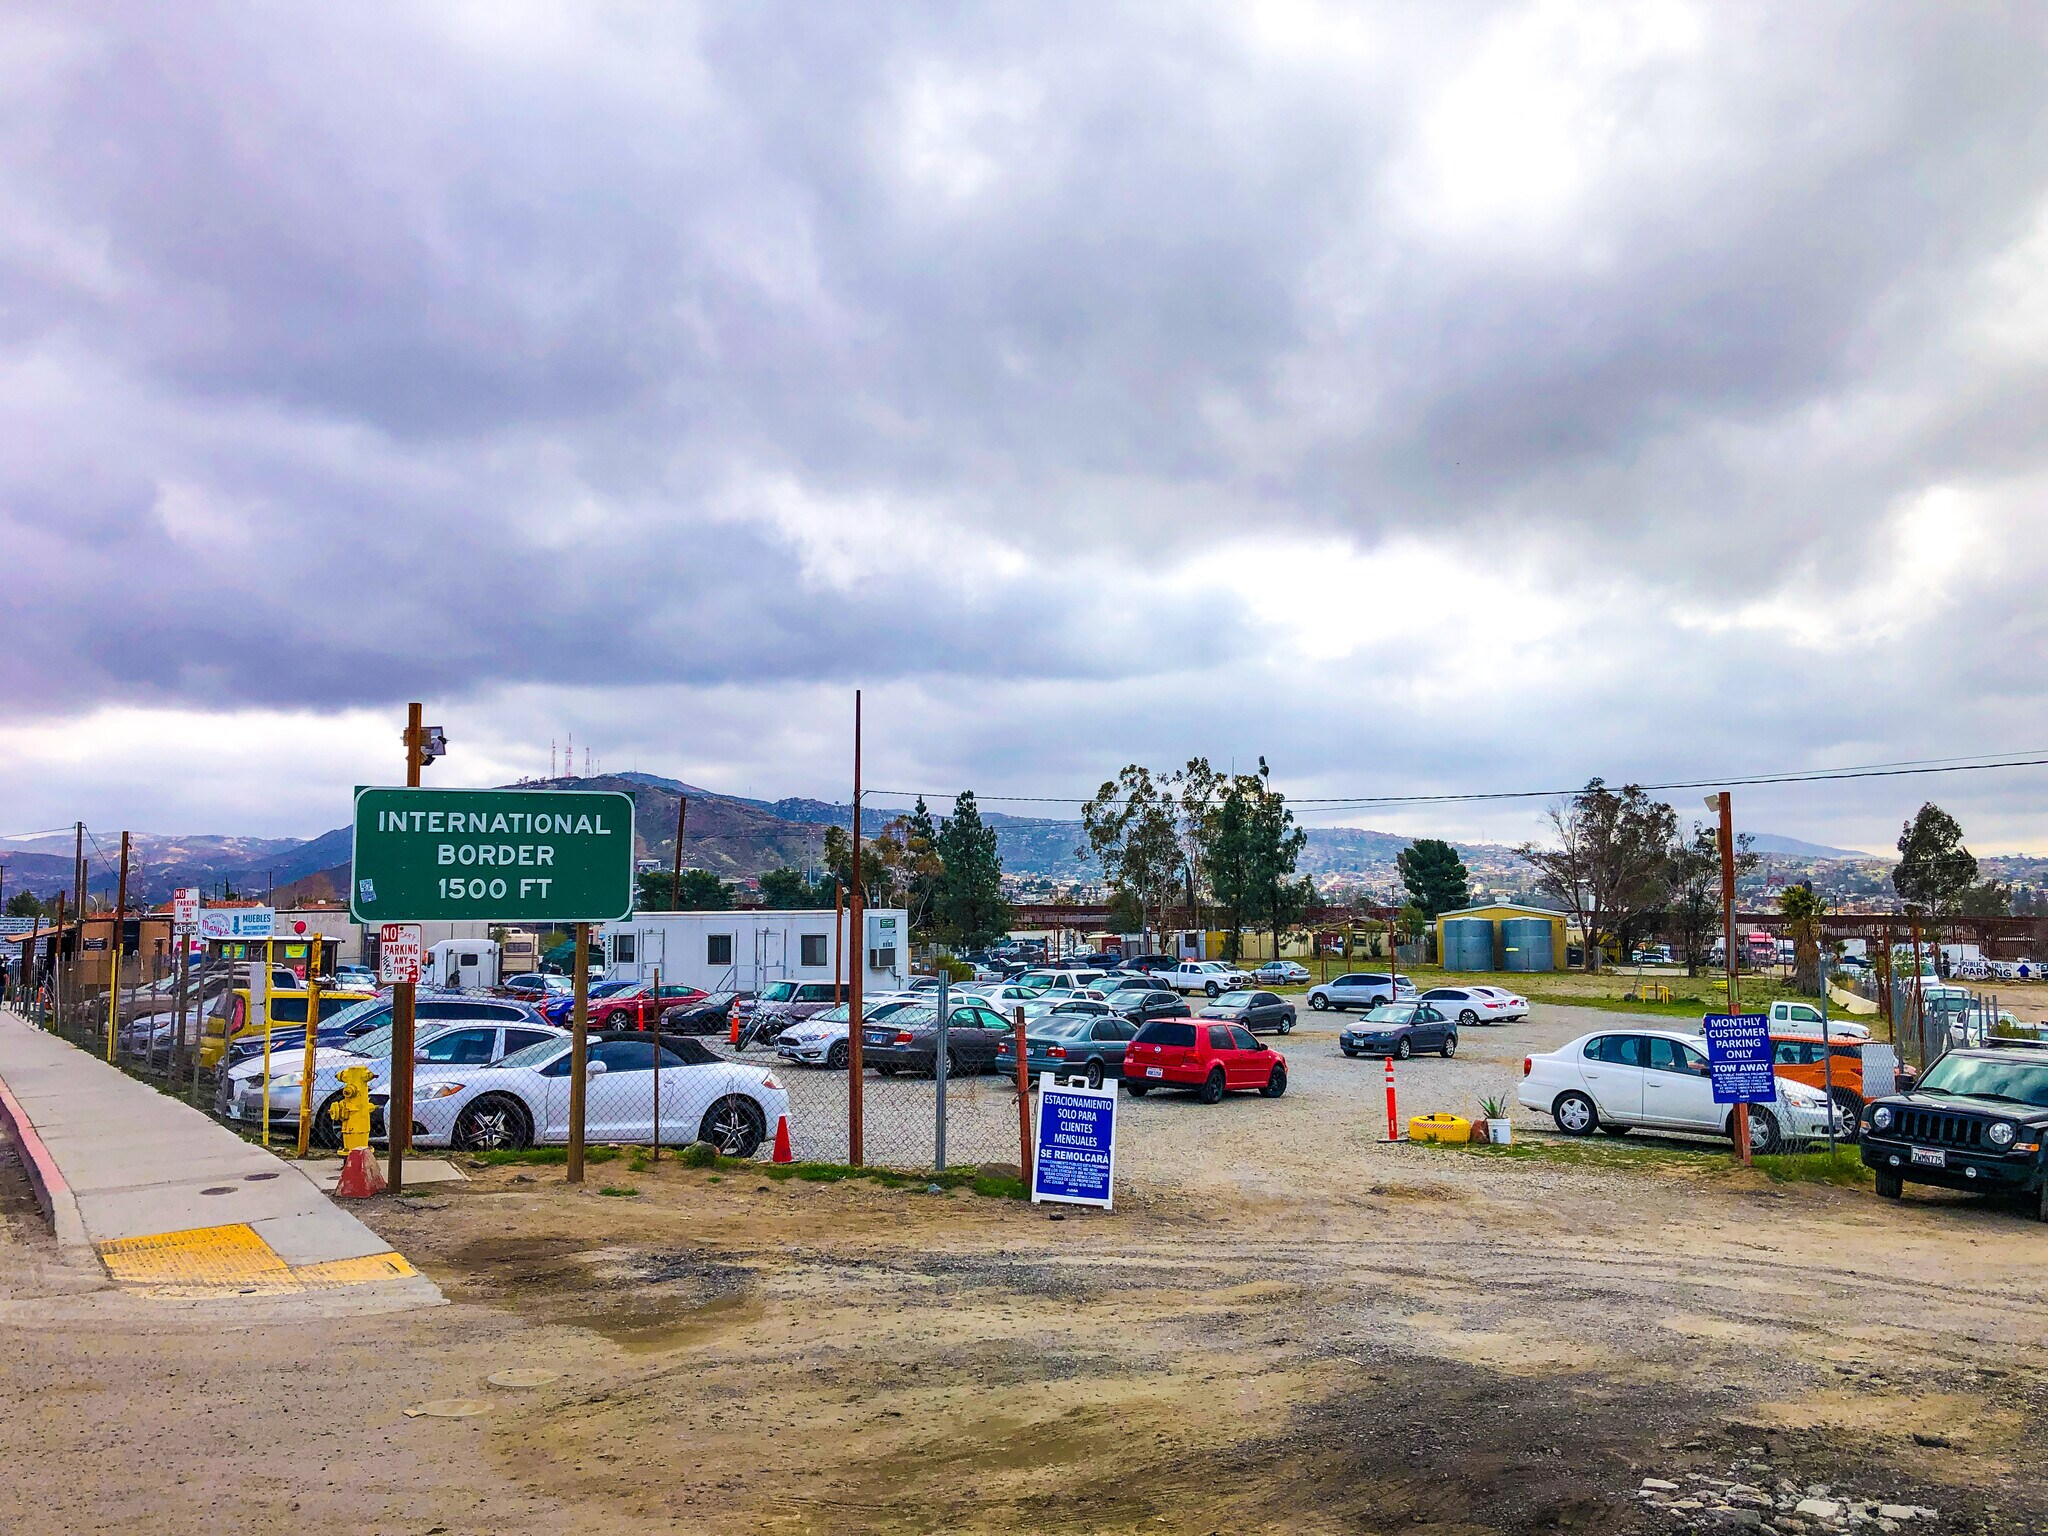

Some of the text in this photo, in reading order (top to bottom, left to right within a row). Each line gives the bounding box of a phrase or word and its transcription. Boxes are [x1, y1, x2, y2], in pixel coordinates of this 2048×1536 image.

[378, 811, 612, 835] INTERNATIONAL
[437, 845, 555, 866] BORDER
[175, 890, 185, 898] NO
[438, 878, 553, 899] 1500 FT
[242, 914, 271, 923] MUEBLES
[382, 926, 397, 940] NO
[384, 943, 418, 956] PARKING
[393, 956, 408, 965] ANY
[392, 966, 409, 975] TIME
[1710, 1017, 1761, 1028] MONTHLY
[1708, 1027, 1766, 1039] CUSTOMER
[1716, 1038, 1761, 1049] PARKING
[1726, 1050, 1753, 1059] ONLY
[1713, 1063, 1769, 1073] TOW AWAY
[1044, 1094, 1112, 1111] ESTACIONAMIENTO
[1057, 1108, 1097, 1122] SOLO PARA
[1060, 1121, 1093, 1134] CLIENTES
[1054, 1133, 1098, 1147] MENSUALES
[1040, 1149, 1109, 1164] SE REMOLCARÁ
